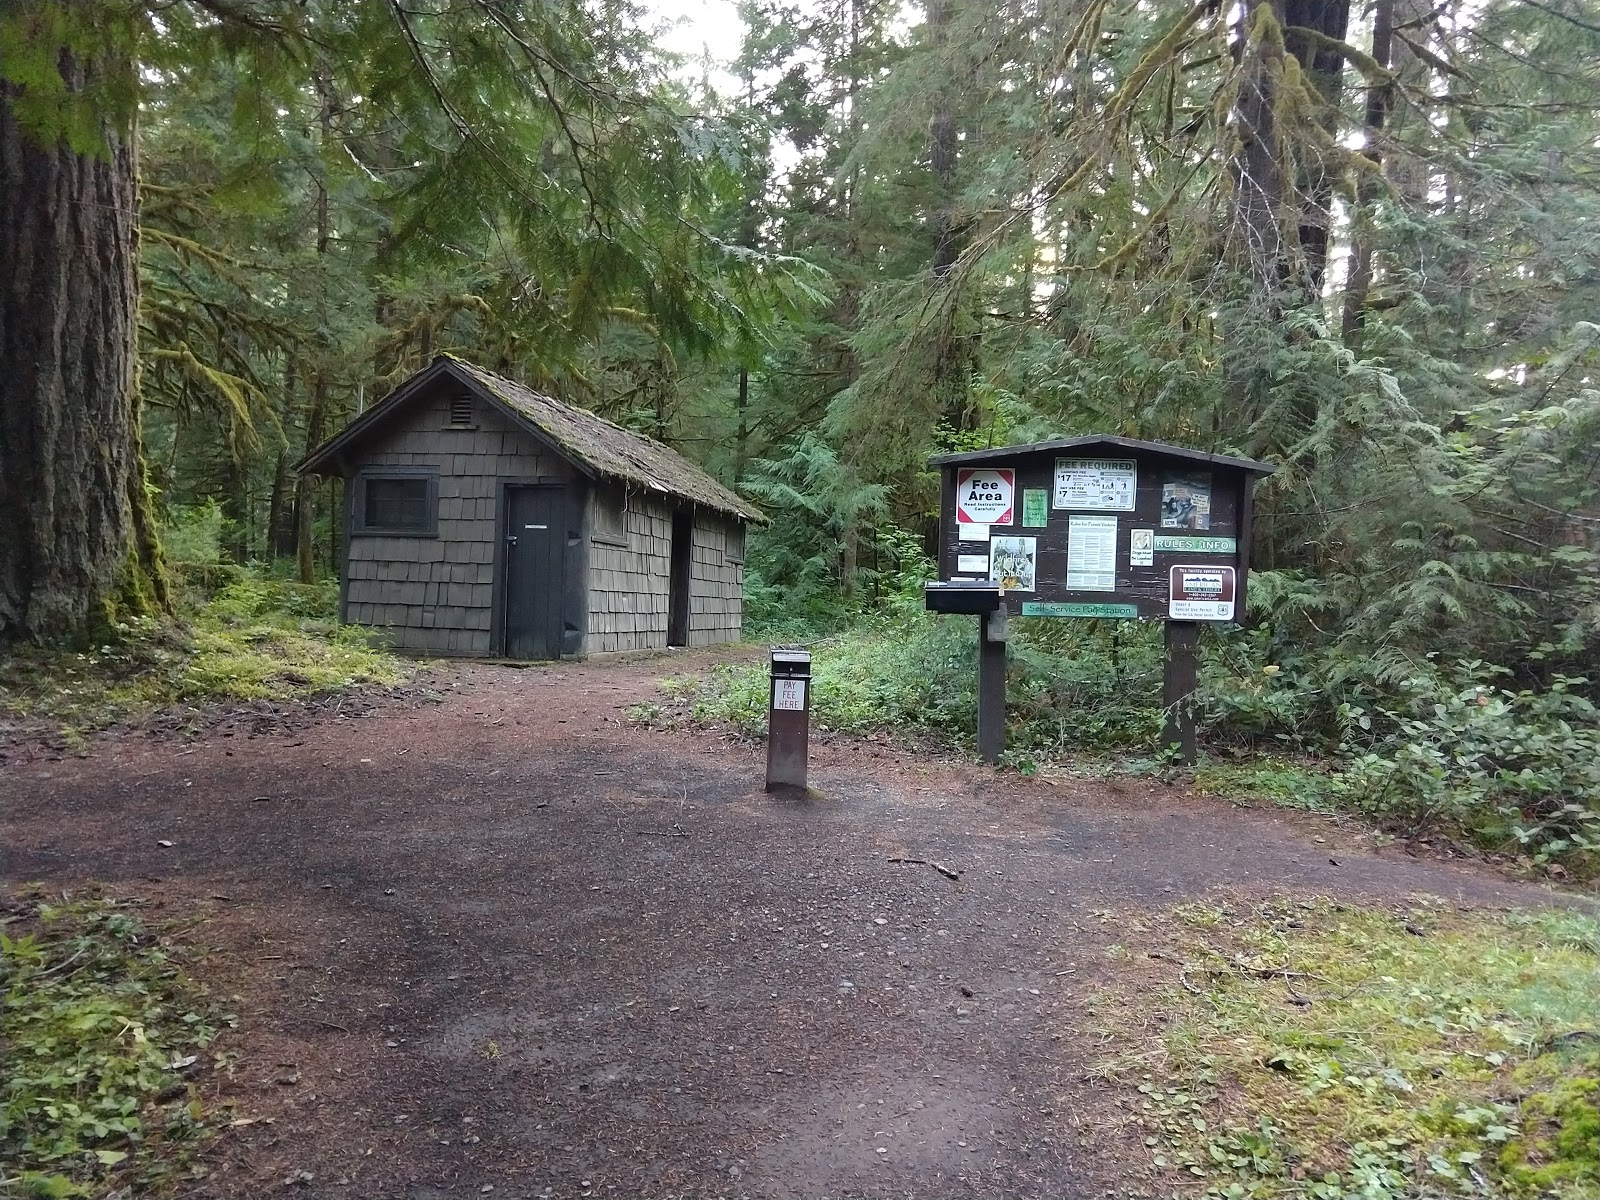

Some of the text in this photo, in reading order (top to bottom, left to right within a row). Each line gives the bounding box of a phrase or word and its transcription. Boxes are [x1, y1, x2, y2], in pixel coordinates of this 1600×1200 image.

[1058, 460, 1132, 470] FEE REQUIRED
[1057, 474, 1072, 482] $17
[972, 479, 999, 490] Fee
[968, 490, 1002, 501] Area
[1059, 490, 1068, 498] $7
[1156, 539, 1230, 550] RULES INFO
[1029, 603, 1131, 615] Self-Service Pay Station
[783, 680, 797, 690] PAY
[782, 690, 797, 700] FEE
[778, 700, 799, 709] HERE
